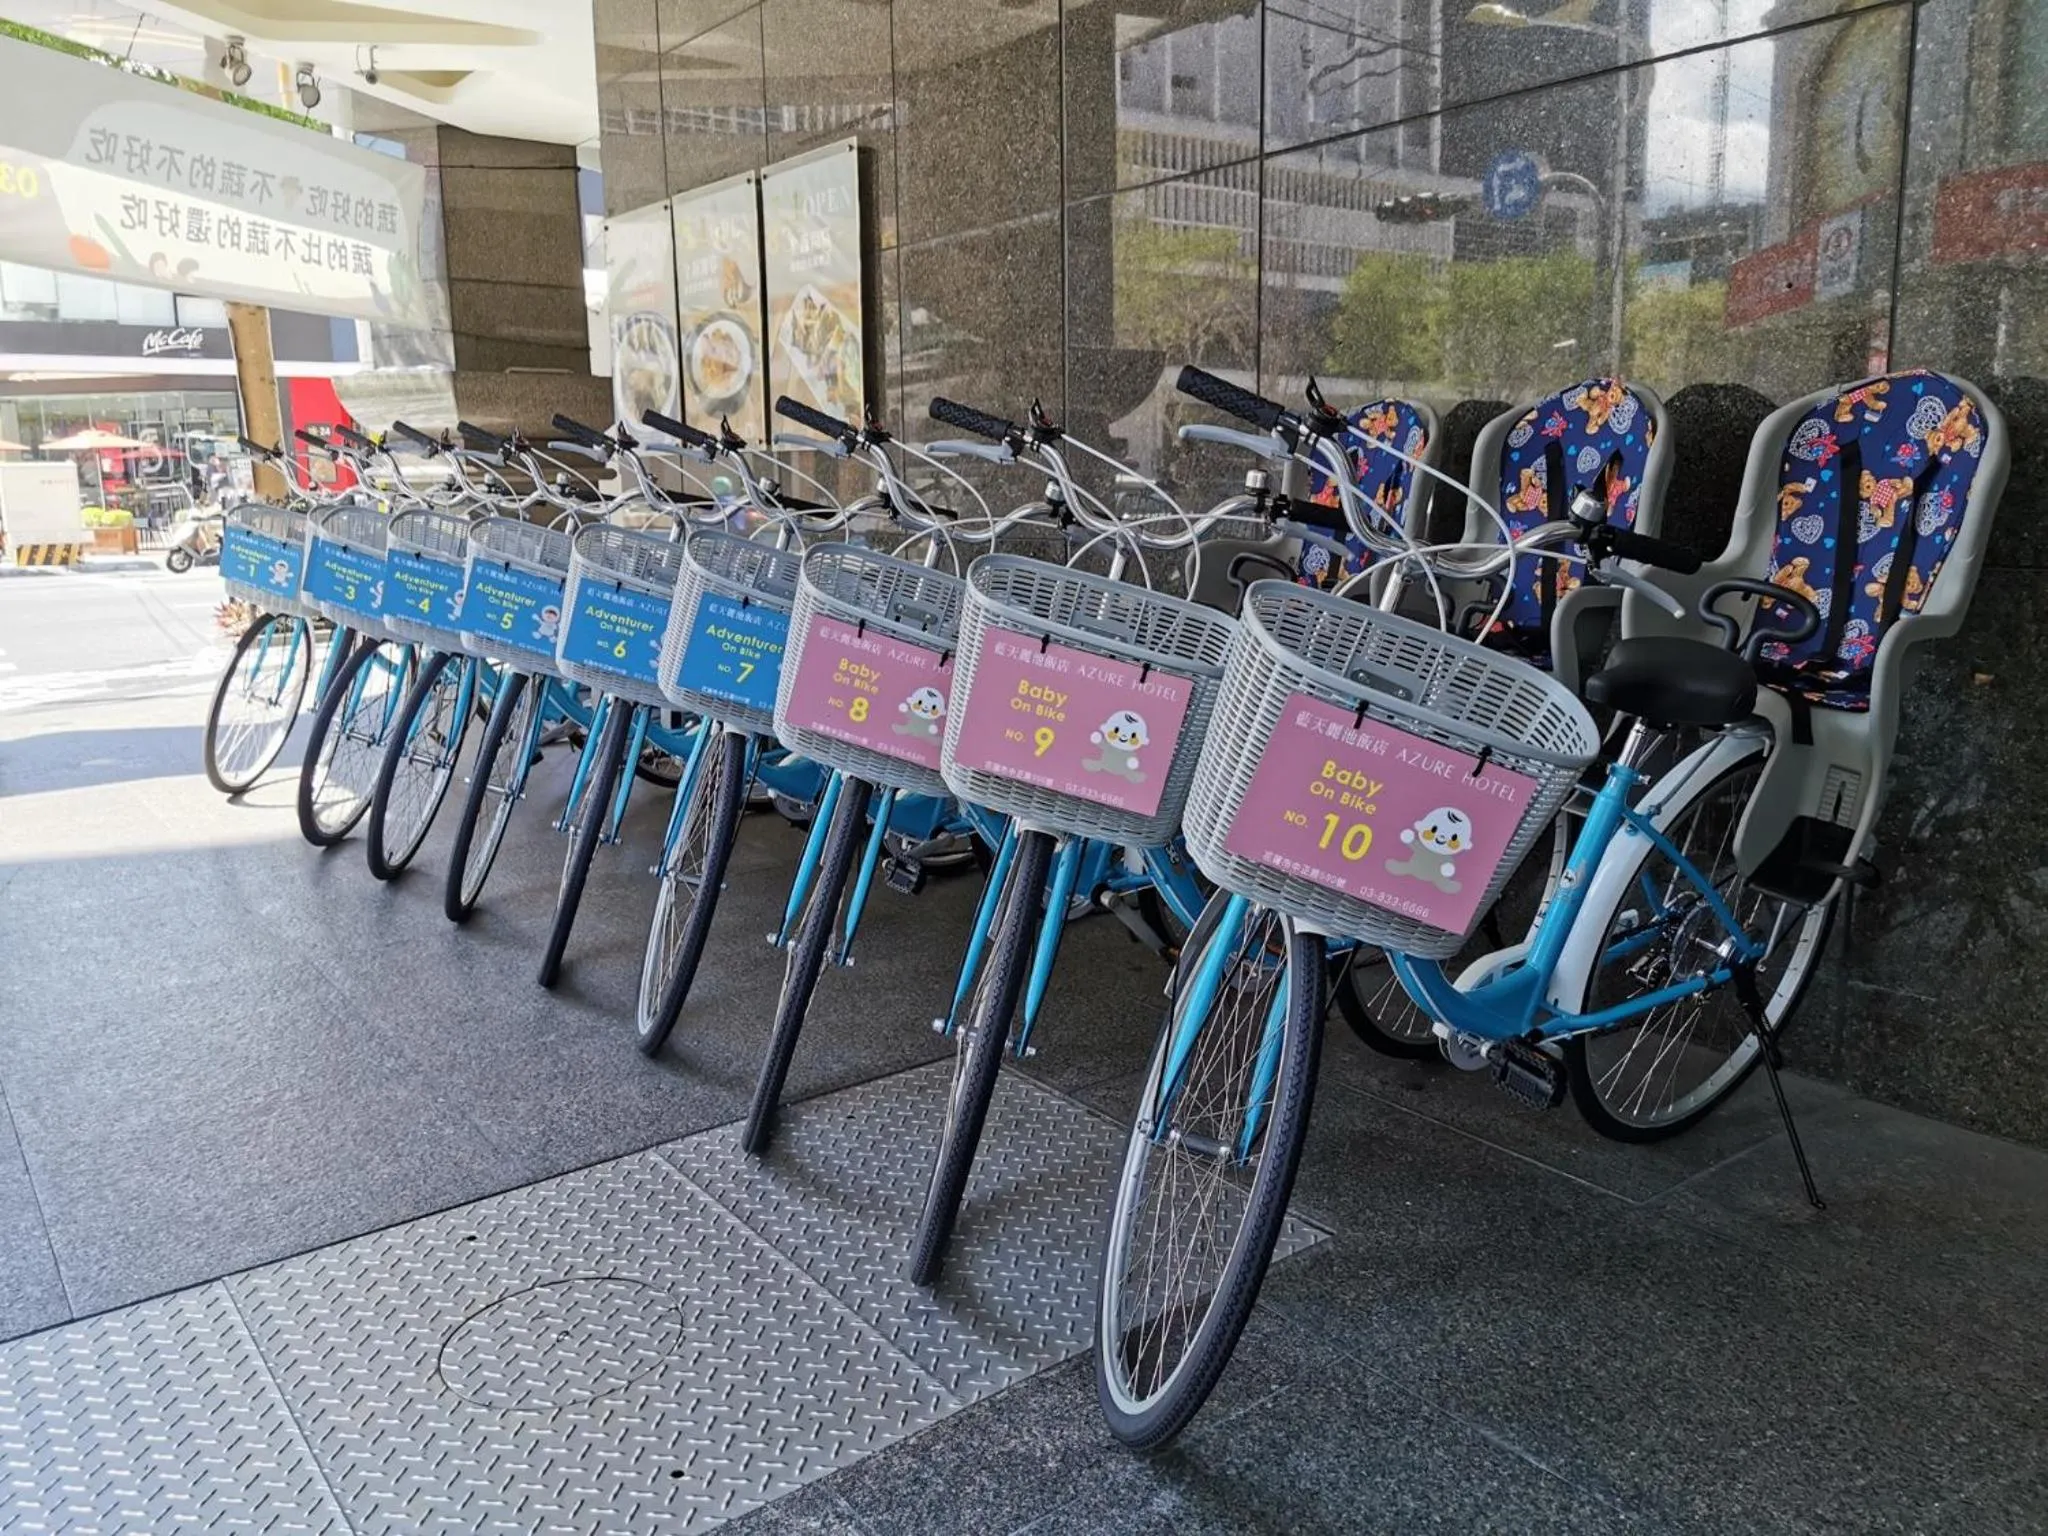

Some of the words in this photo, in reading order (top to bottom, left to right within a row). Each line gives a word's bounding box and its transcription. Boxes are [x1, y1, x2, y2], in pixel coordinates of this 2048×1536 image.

[249, 564, 256, 577] 1
[394, 571, 448, 592] Adventurer
[344, 586, 356, 600] 3
[476, 582, 536, 607] Adventurer
[418, 598, 431, 614] 4
[585, 605, 654, 632] Adventurer
[500, 613, 516, 630] 5
[600, 620, 613, 631] On
[613, 640, 626, 659] 6
[706, 624, 784, 654] Adventurer
[722, 642, 737, 654] On
[740, 646, 761, 660] Bike
[736, 662, 754, 684] 7
[839, 657, 881, 682] Baby
[833, 672, 850, 686] On
[854, 678, 879, 695] Bike
[1018, 679, 1068, 708] Baby
[1077, 667, 1125, 688] AZURE
[1132, 679, 1177, 702] HOTEL
[849, 697, 870, 722] 8
[1010, 698, 1031, 713] On
[1036, 704, 1066, 722] Bike
[1034, 726, 1055, 758] 9
[1320, 760, 1384, 798] Baby
[1396, 748, 1454, 779] AZURE
[1461, 771, 1518, 802] HOTEL
[1310, 780, 1335, 800] On
[1340, 790, 1378, 816] Bike
[1284, 809, 1309, 828] NO.
[1318, 812, 1373, 861] 10
